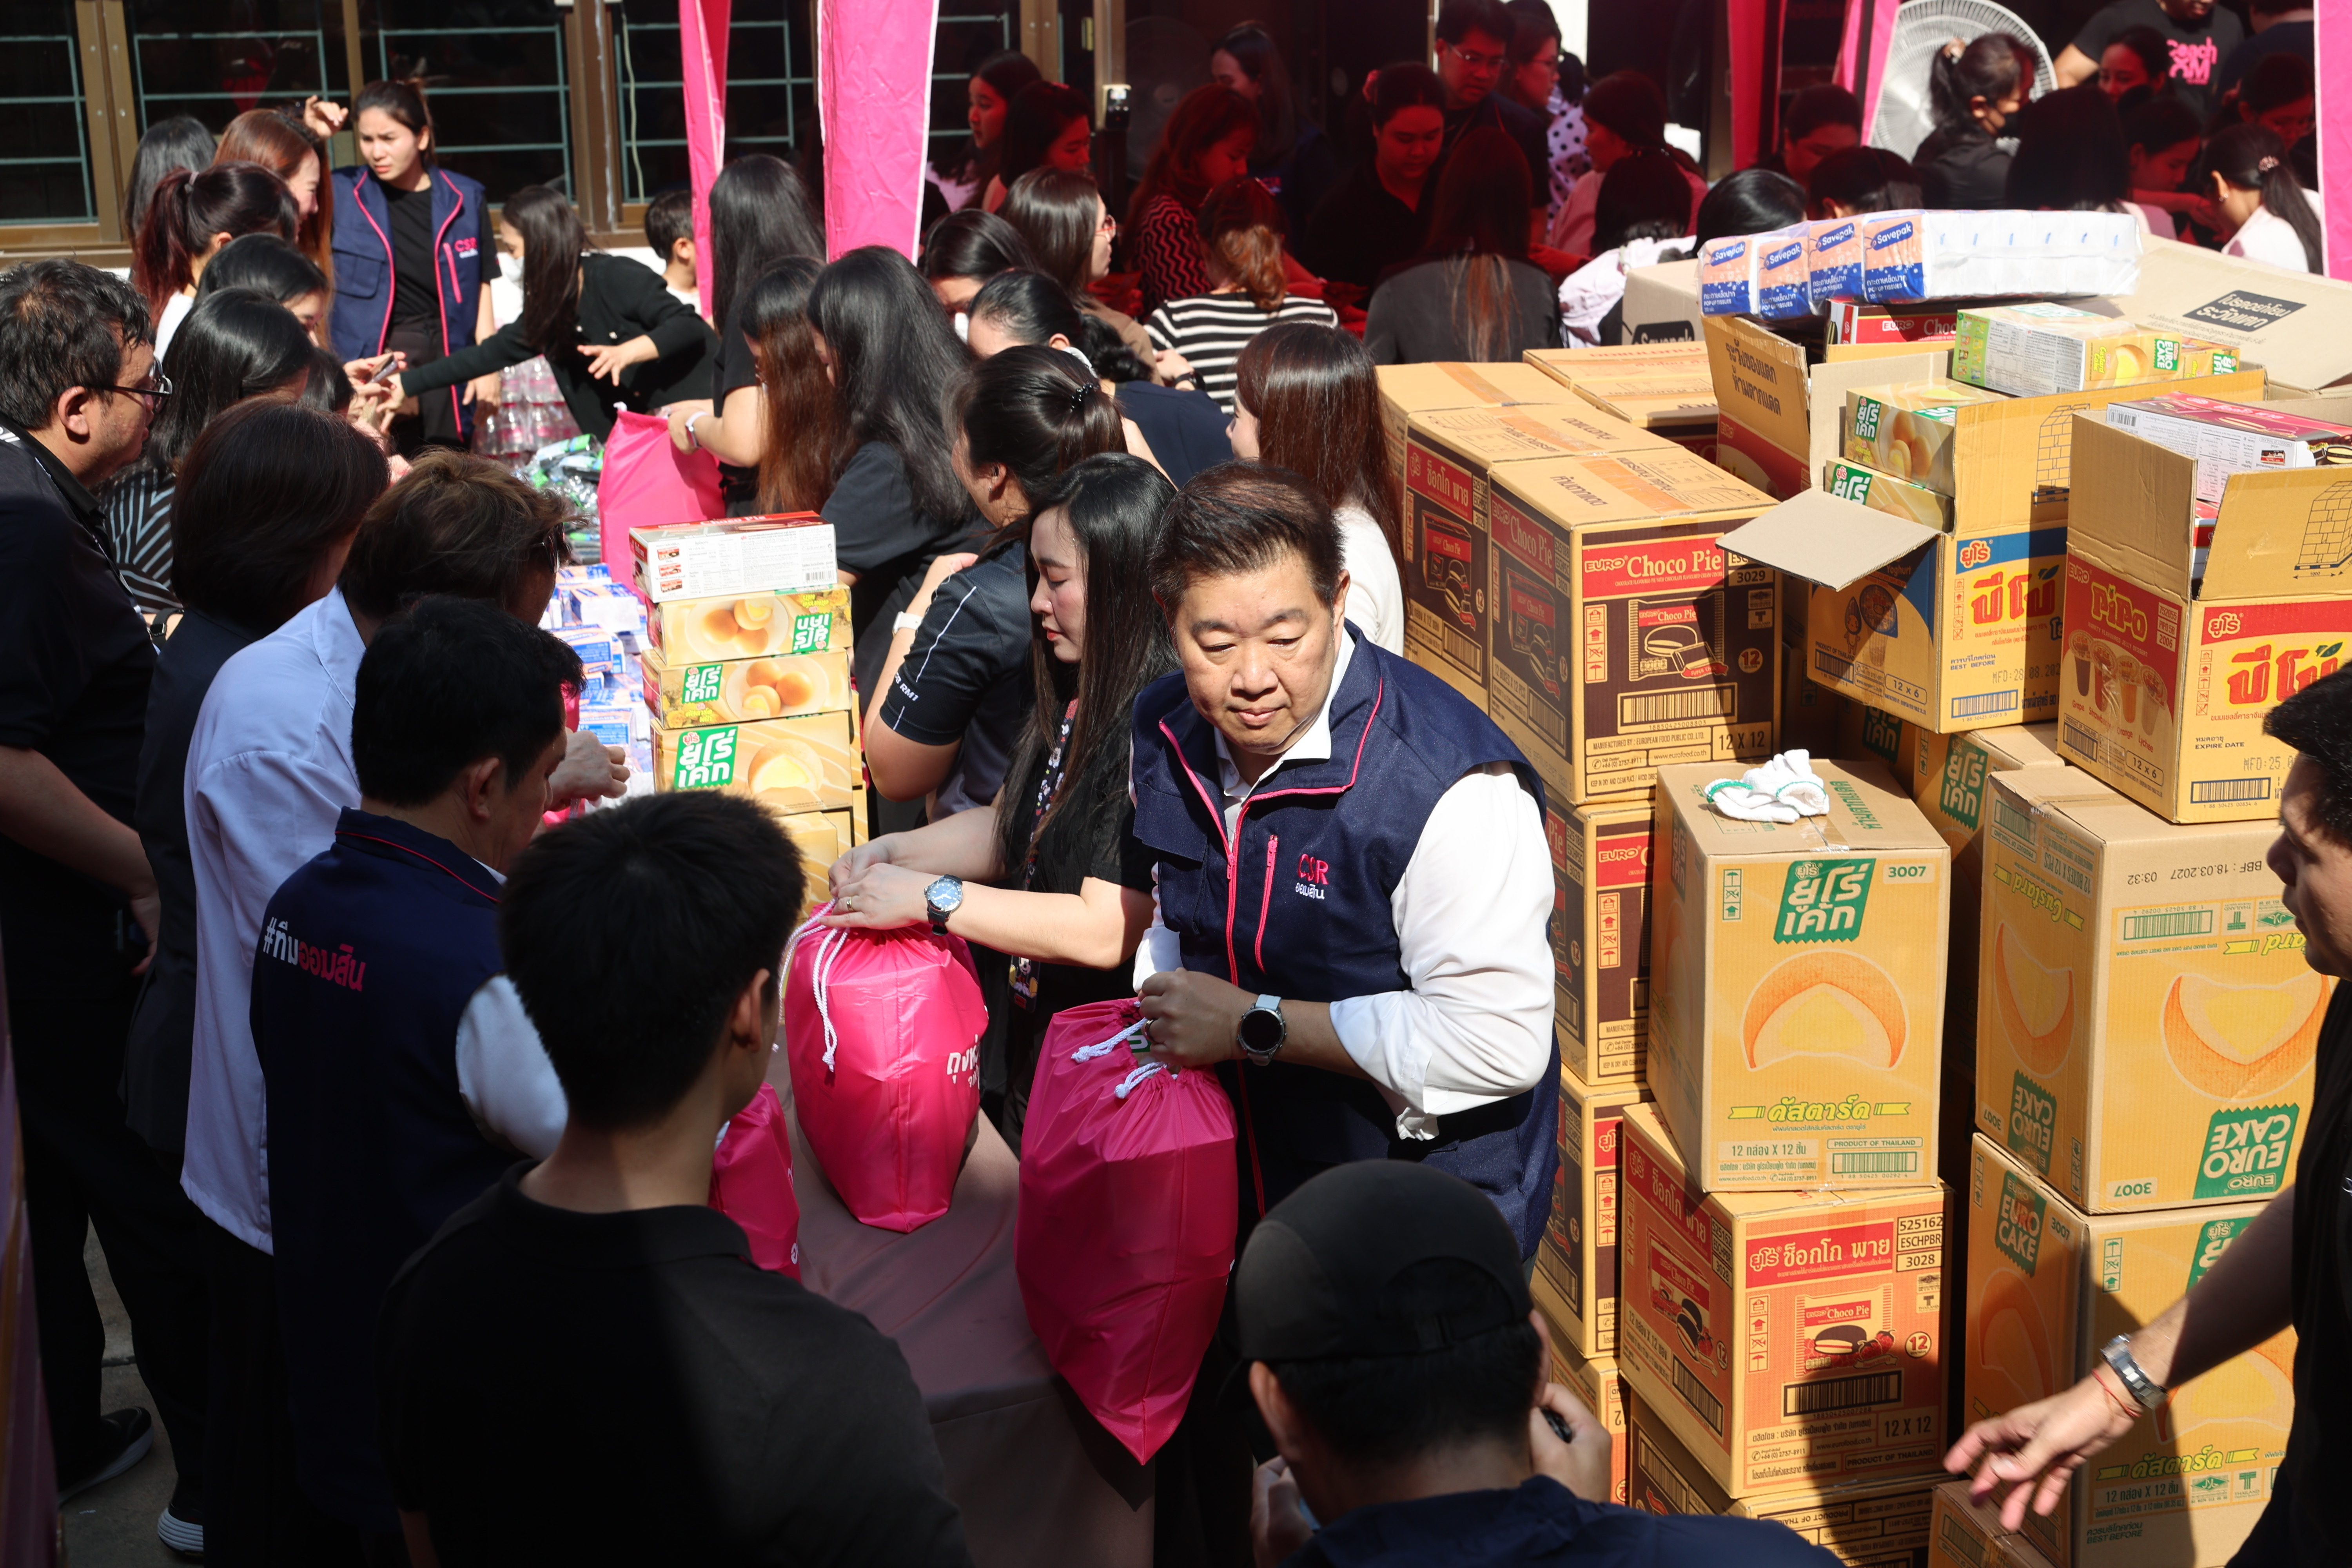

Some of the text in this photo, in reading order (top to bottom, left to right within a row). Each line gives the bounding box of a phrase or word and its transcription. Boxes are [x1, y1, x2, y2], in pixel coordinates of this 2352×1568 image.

[454, 237, 478, 252] CSR
[1822, 225, 1854, 246] Savepak
[1715, 242, 1744, 260] Savepak
[1769, 245, 1801, 264] Savepak
[1882, 318, 1957, 335] EURO Choc
[2196, 306, 2269, 328] ระวังแตก
[1726, 339, 1777, 385] ระวังของแตก
[2156, 341, 2165, 368] CAKE
[2165, 341, 2173, 369] EURO
[1732, 365, 1781, 416] ห้ามตากแดด
[1492, 500, 1553, 569] EURO Choco Pie
[1584, 549, 1722, 578] EURO Choco Pie
[1960, 542, 1990, 568] ยูโร่
[1737, 570, 1766, 583] 3029
[1886, 564, 1912, 576] Yoghurt
[1971, 564, 2060, 624] ปีโป้
[2159, 605, 2177, 621] 752055
[2208, 612, 2241, 639] ยูโร่
[2159, 633, 2173, 648] 2006
[1742, 650, 1760, 666] 12
[1951, 653, 1996, 664] ควรบริโภคก่อน
[900, 683, 919, 702] RM1
[1893, 679, 1919, 698] 12 x 6
[2050, 694, 2056, 705] 90
[2072, 699, 2085, 712] Grape
[1649, 720, 1707, 731] 18850425008803
[2117, 726, 2133, 740] Orange
[1593, 739, 1627, 750] MANUFACTURED
[1627, 739, 1633, 747] BY
[1636, 737, 1659, 745] EUROPEAN
[1659, 735, 1670, 743] FOOD
[1671, 733, 1686, 742] PUBLIC
[1719, 730, 1765, 752] 12 X 12
[2138, 734, 2154, 753] Lychee
[2195, 735, 2224, 745] หมดอายุ
[1654, 749, 1707, 760] www.eurofood.co.th
[2132, 757, 2157, 779] 12 x 6
[1829, 780, 1883, 830] ห้ามตากแดด
[1944, 783, 1977, 817] เค้ก
[1548, 815, 1563, 855] Pie
[1599, 847, 1639, 864] EURO
[2044, 851, 2054, 872] PCS
[1297, 853, 1329, 886] CSR
[1888, 866, 1926, 878] 3007
[2054, 858, 2062, 876] 12
[2062, 864, 2067, 879] X
[2170, 863, 2229, 880] 18.03.2027
[2239, 860, 2262, 873] BBF
[2067, 865, 2084, 891] BOXES
[2083, 877, 2091, 895] 12
[2127, 871, 2158, 886] 03:32
[1295, 882, 1325, 900] ออมสิน
[1788, 863, 1871, 913] ยูโร่
[2011, 872, 2063, 923] Custard
[1783, 903, 1856, 936] เค้ก
[263, 916, 366, 992] #ทีมออมสิน
[1768, 1094, 1870, 1122] คัสตาร์ด
[2015, 1084, 2053, 1126] CAKE
[1983, 1109, 2002, 1131] 3007
[2211, 1113, 2292, 1150] CAKE
[1732, 1142, 1806, 1157] 12 กล่อง X 12 ชิ้น
[2203, 1140, 2287, 1179] EURO
[2114, 1181, 2152, 1198] 3007
[1652, 1167, 1682, 1221] ช็อกโก
[1685, 1208, 1706, 1244] พาย
[1900, 1216, 1943, 1232] 525162
[1712, 1221, 1732, 1247] 525162
[1900, 1234, 1942, 1248] ESCHPBR
[1750, 1247, 1779, 1272] ยูโร่
[1784, 1238, 1842, 1268] ช็อกโก
[1851, 1237, 1890, 1257] พาย
[1905, 1254, 1935, 1267] 3028
[1716, 1259, 1730, 1282] 3028
[1909, 1336, 1928, 1351] 12
[1884, 1416, 1931, 1437] 12 X 12
[1779, 1448, 1806, 1458] 2757-8911
[1816, 1437, 1872, 1451] www.eurofood.co.th
[1847, 1455, 1882, 1467] PRODUCT
[1897, 1449, 1934, 1459] THAILAND
[2131, 1445, 2223, 1480] คัสตาร์ด
[2106, 1480, 2179, 1503] 12 กล่อง X 12 ชิ้น
[2087, 1530, 2143, 1544] BEST BEFORE
